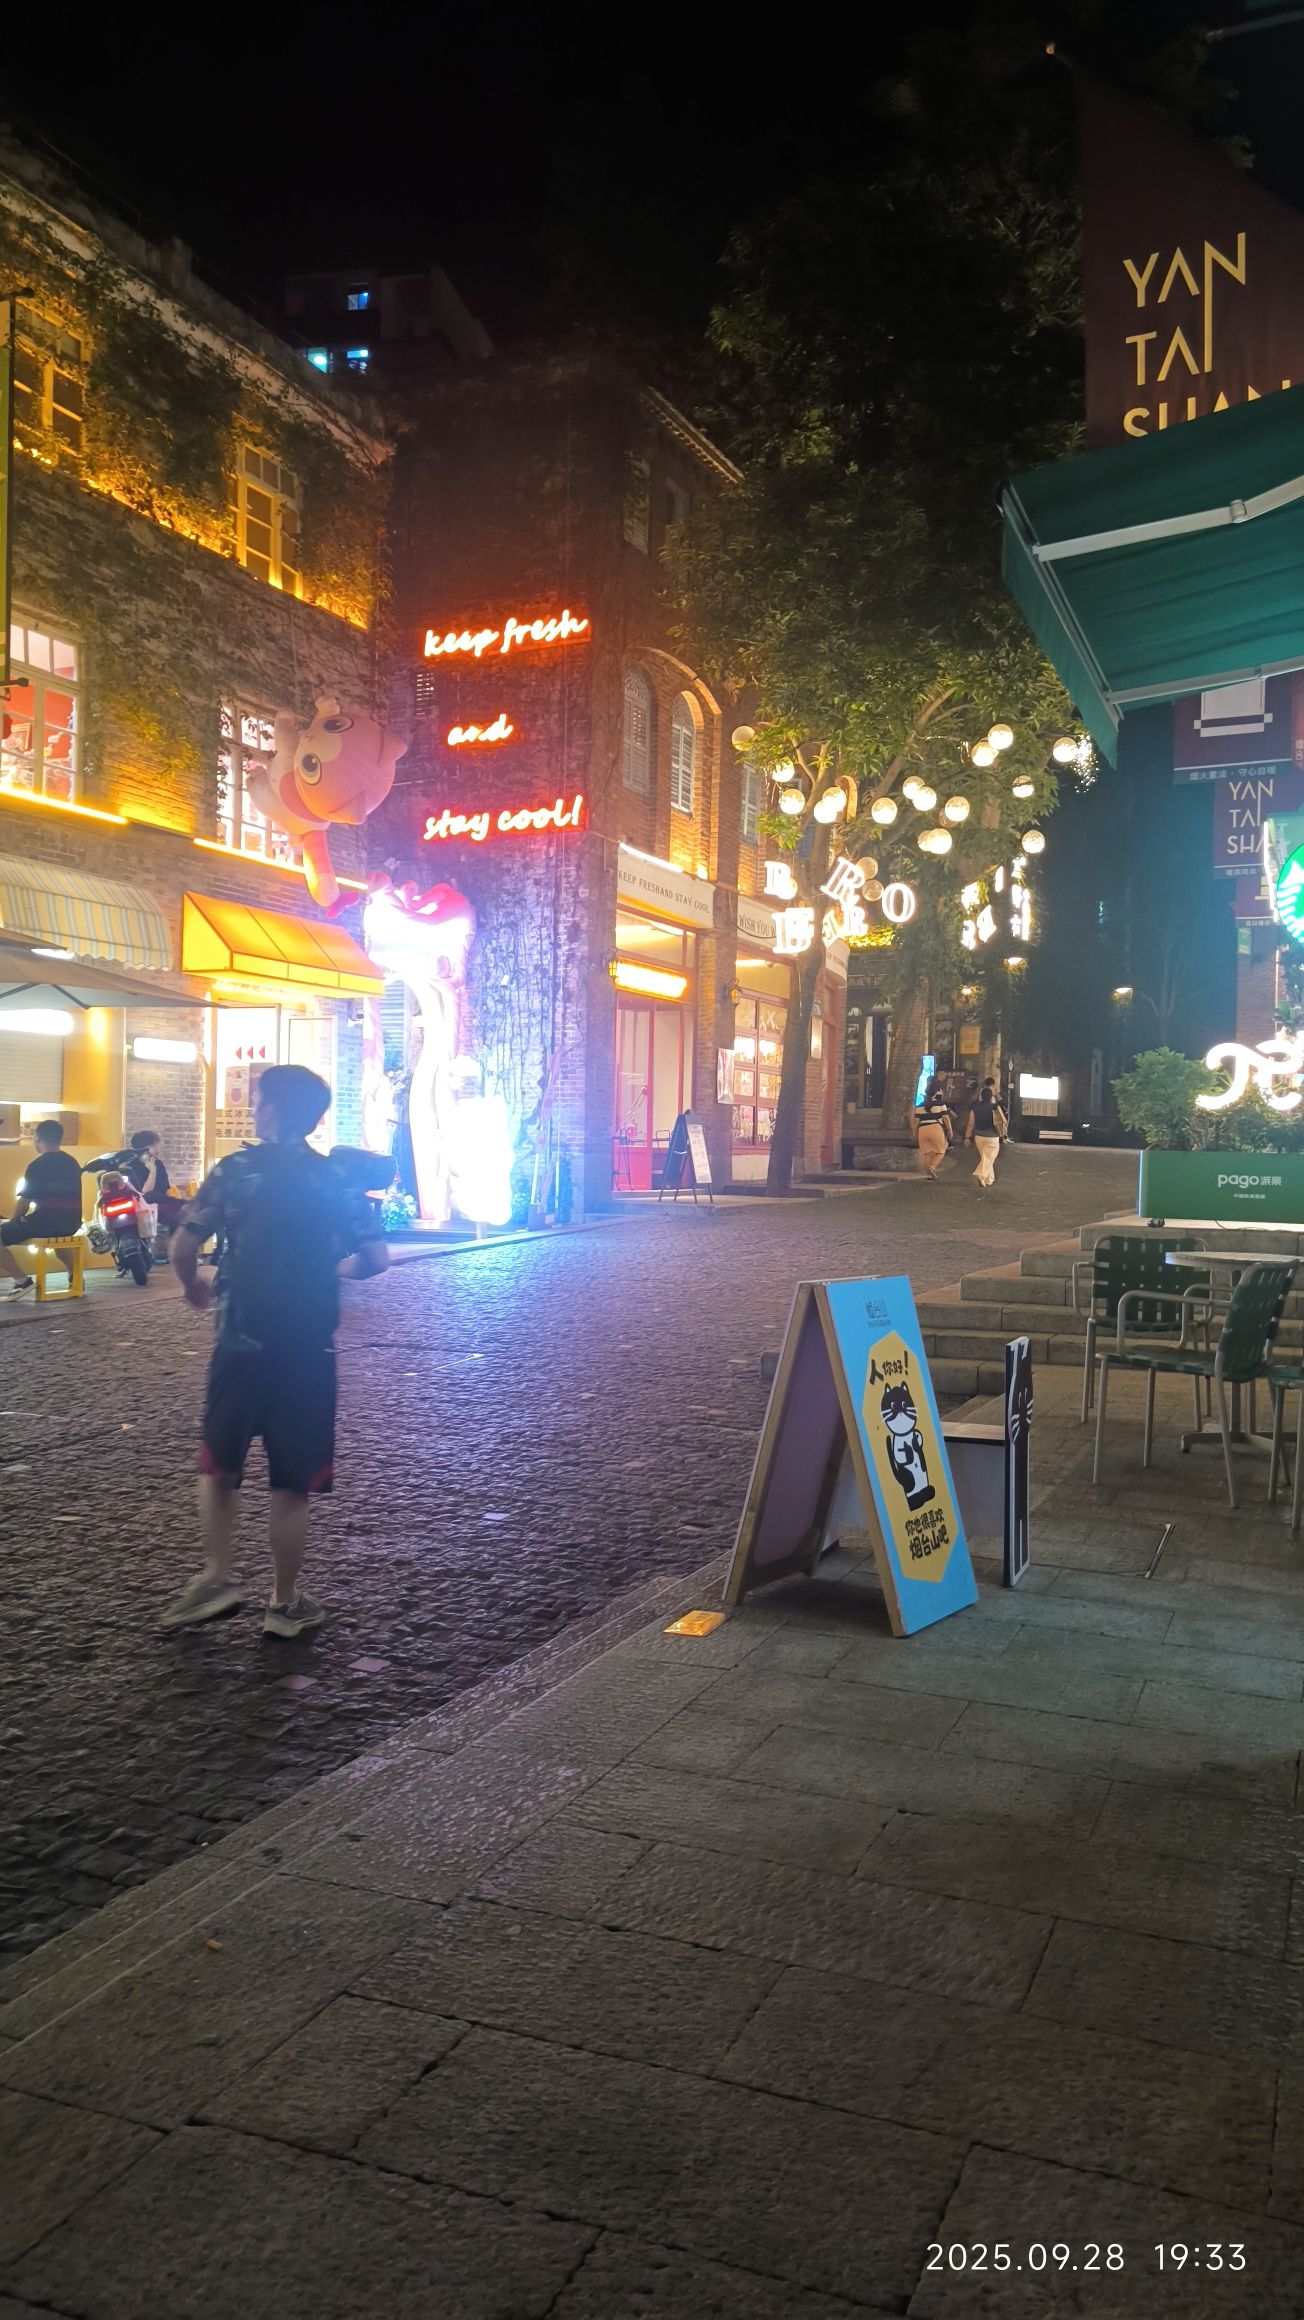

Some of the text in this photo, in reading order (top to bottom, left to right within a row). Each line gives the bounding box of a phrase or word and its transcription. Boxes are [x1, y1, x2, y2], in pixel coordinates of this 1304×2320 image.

[1123, 232, 1246, 308] YAN
[424, 609, 589, 657] keep fresh
[447, 713, 514, 746] and
[1229, 779, 1274, 801] YAN
[423, 794, 584, 841] stay cool!
[617, 869, 638, 886] KEEP
[675, 892, 694, 906] STAY
[694, 899, 711, 915] COOL
[738, 914, 757, 934] WISH
[757, 918, 770, 937] YOU
[1217, 1174, 1260, 1189] pago
[909, 1524, 950, 1561] 烟台山吧
